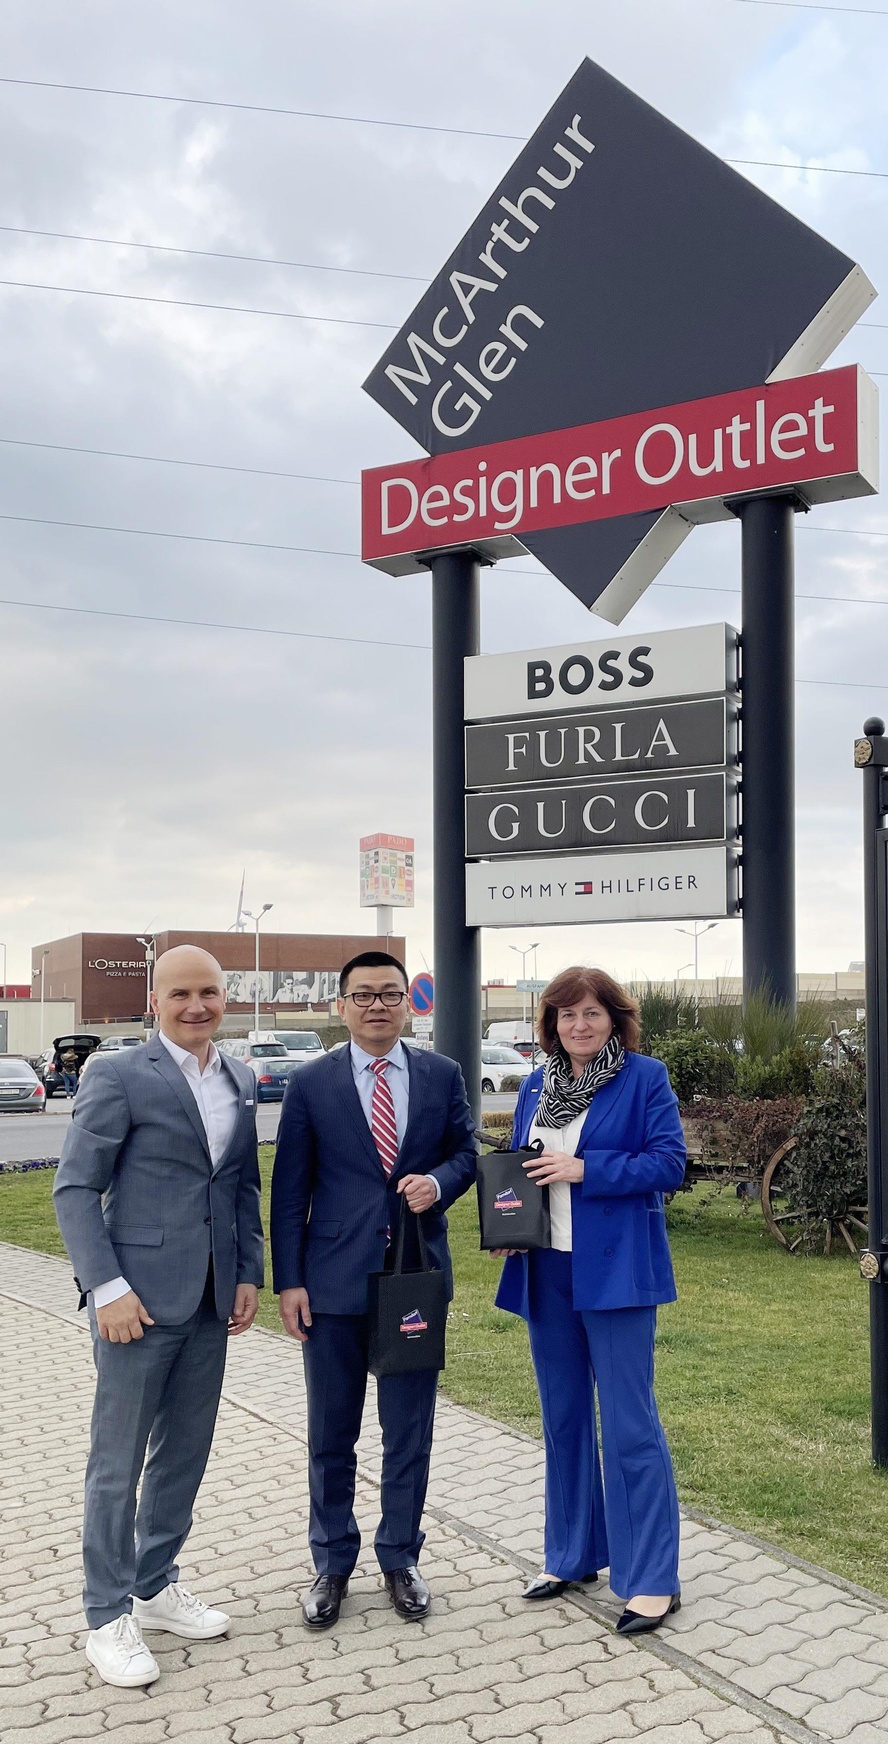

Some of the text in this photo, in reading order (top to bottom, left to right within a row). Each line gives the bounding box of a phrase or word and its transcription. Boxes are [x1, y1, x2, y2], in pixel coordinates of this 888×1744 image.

[384, 113, 596, 406] McArthur
[431, 303, 545, 437] Glen
[380, 396, 836, 530] Designer Outlet
[527, 646, 654, 700] BOSS
[504, 717, 680, 771] FURLA
[488, 788, 697, 842] GUCCI
[488, 875, 699, 900] TOMMY HILFIGER
